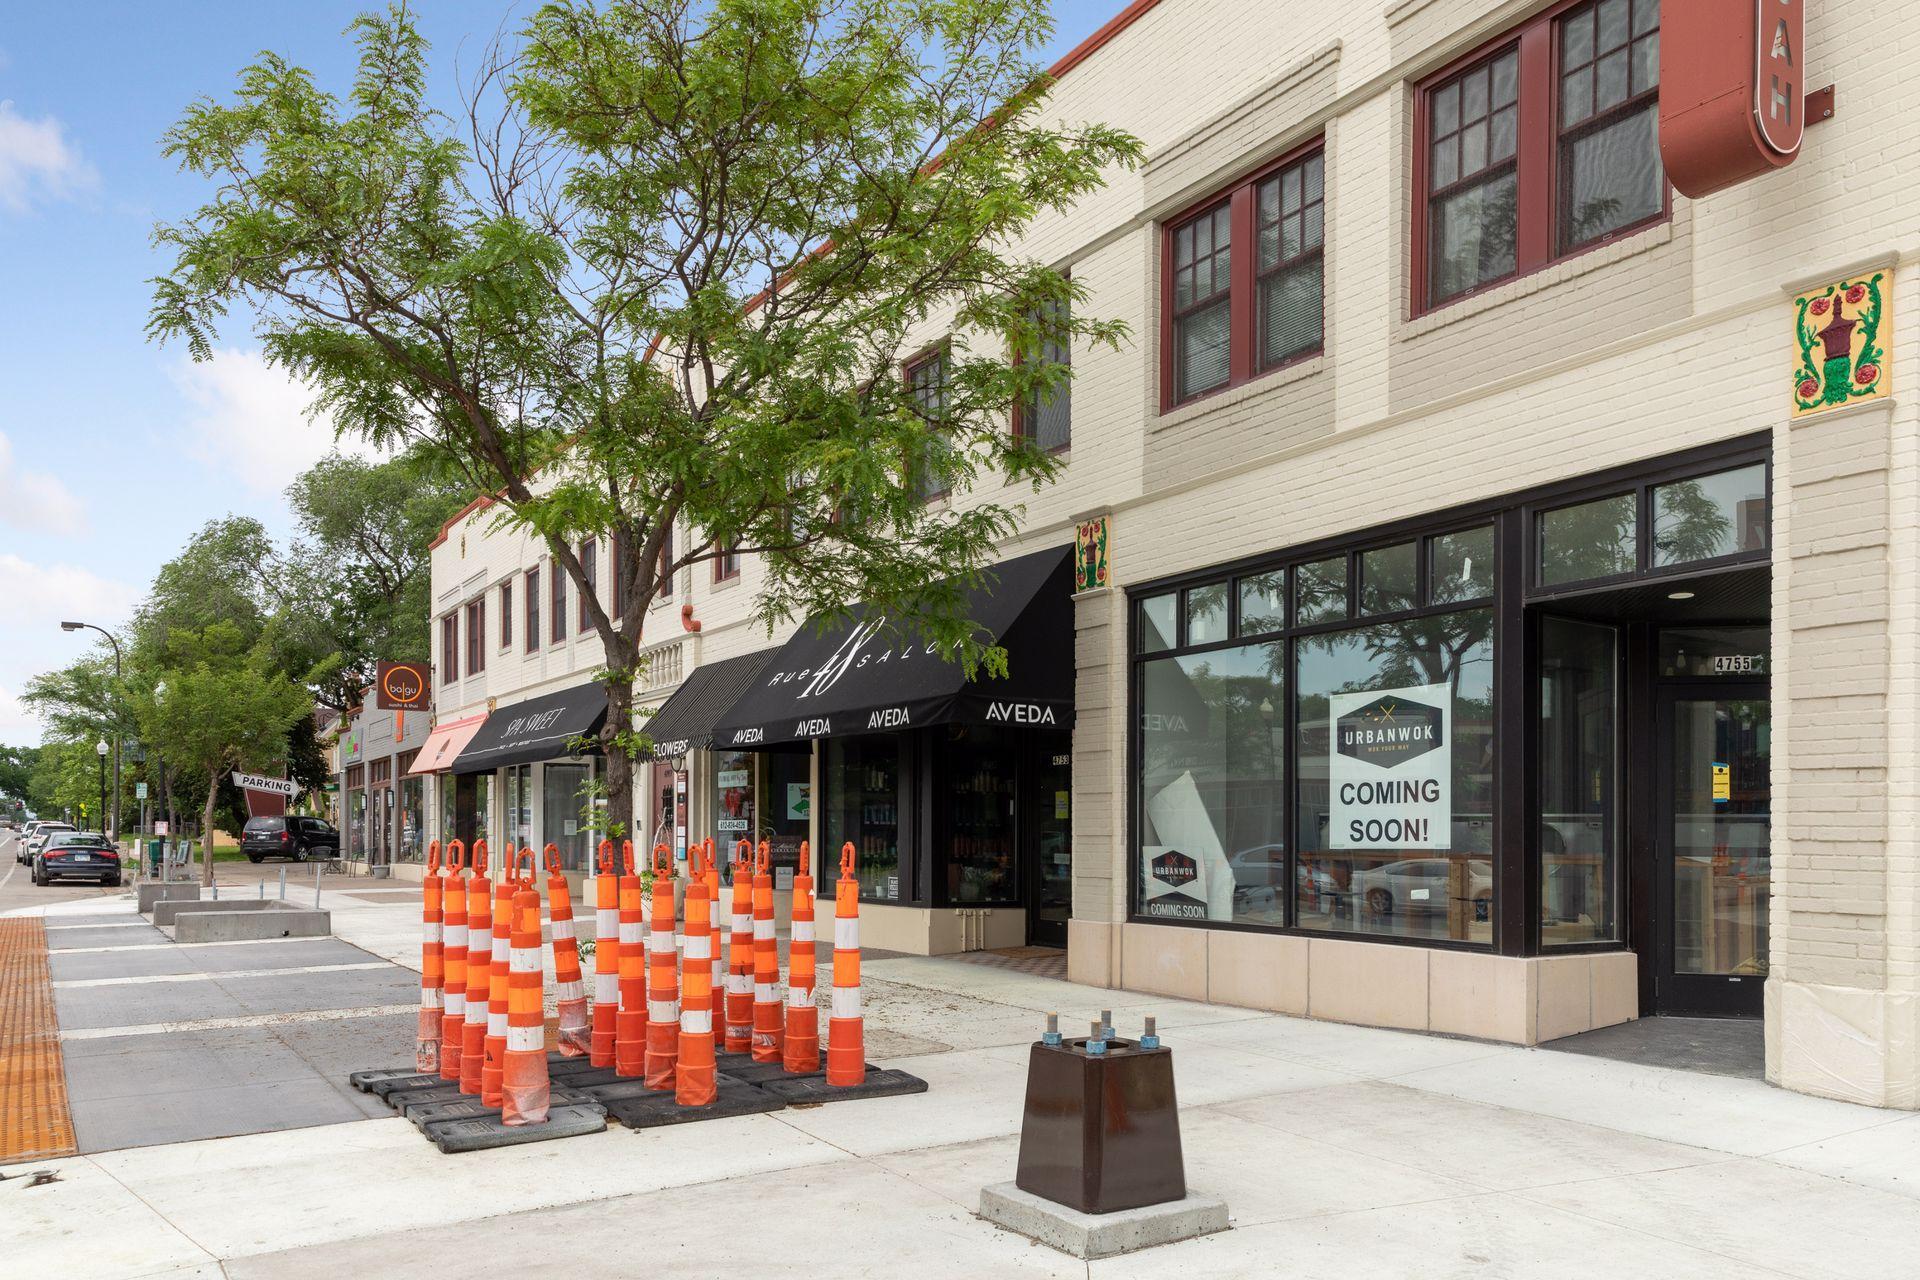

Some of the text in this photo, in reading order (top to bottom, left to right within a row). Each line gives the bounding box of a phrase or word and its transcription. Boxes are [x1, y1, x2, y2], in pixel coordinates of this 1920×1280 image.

[1716, 657, 1750, 670] 4755
[500, 707, 566, 739] SPA SWEET
[867, 706, 910, 729] AVEDA
[985, 701, 1056, 725] AVEDA
[732, 727, 764, 744] AVEDA
[794, 717, 831, 737] AVEDA
[1345, 725, 1433, 745] URBANWOK
[653, 739, 688, 757] FLOWERS
[242, 776, 291, 792] PARKING
[1339, 778, 1440, 806] COMING
[1349, 818, 1428, 843] SOON!
[1150, 903, 1205, 919] COMING SOON
